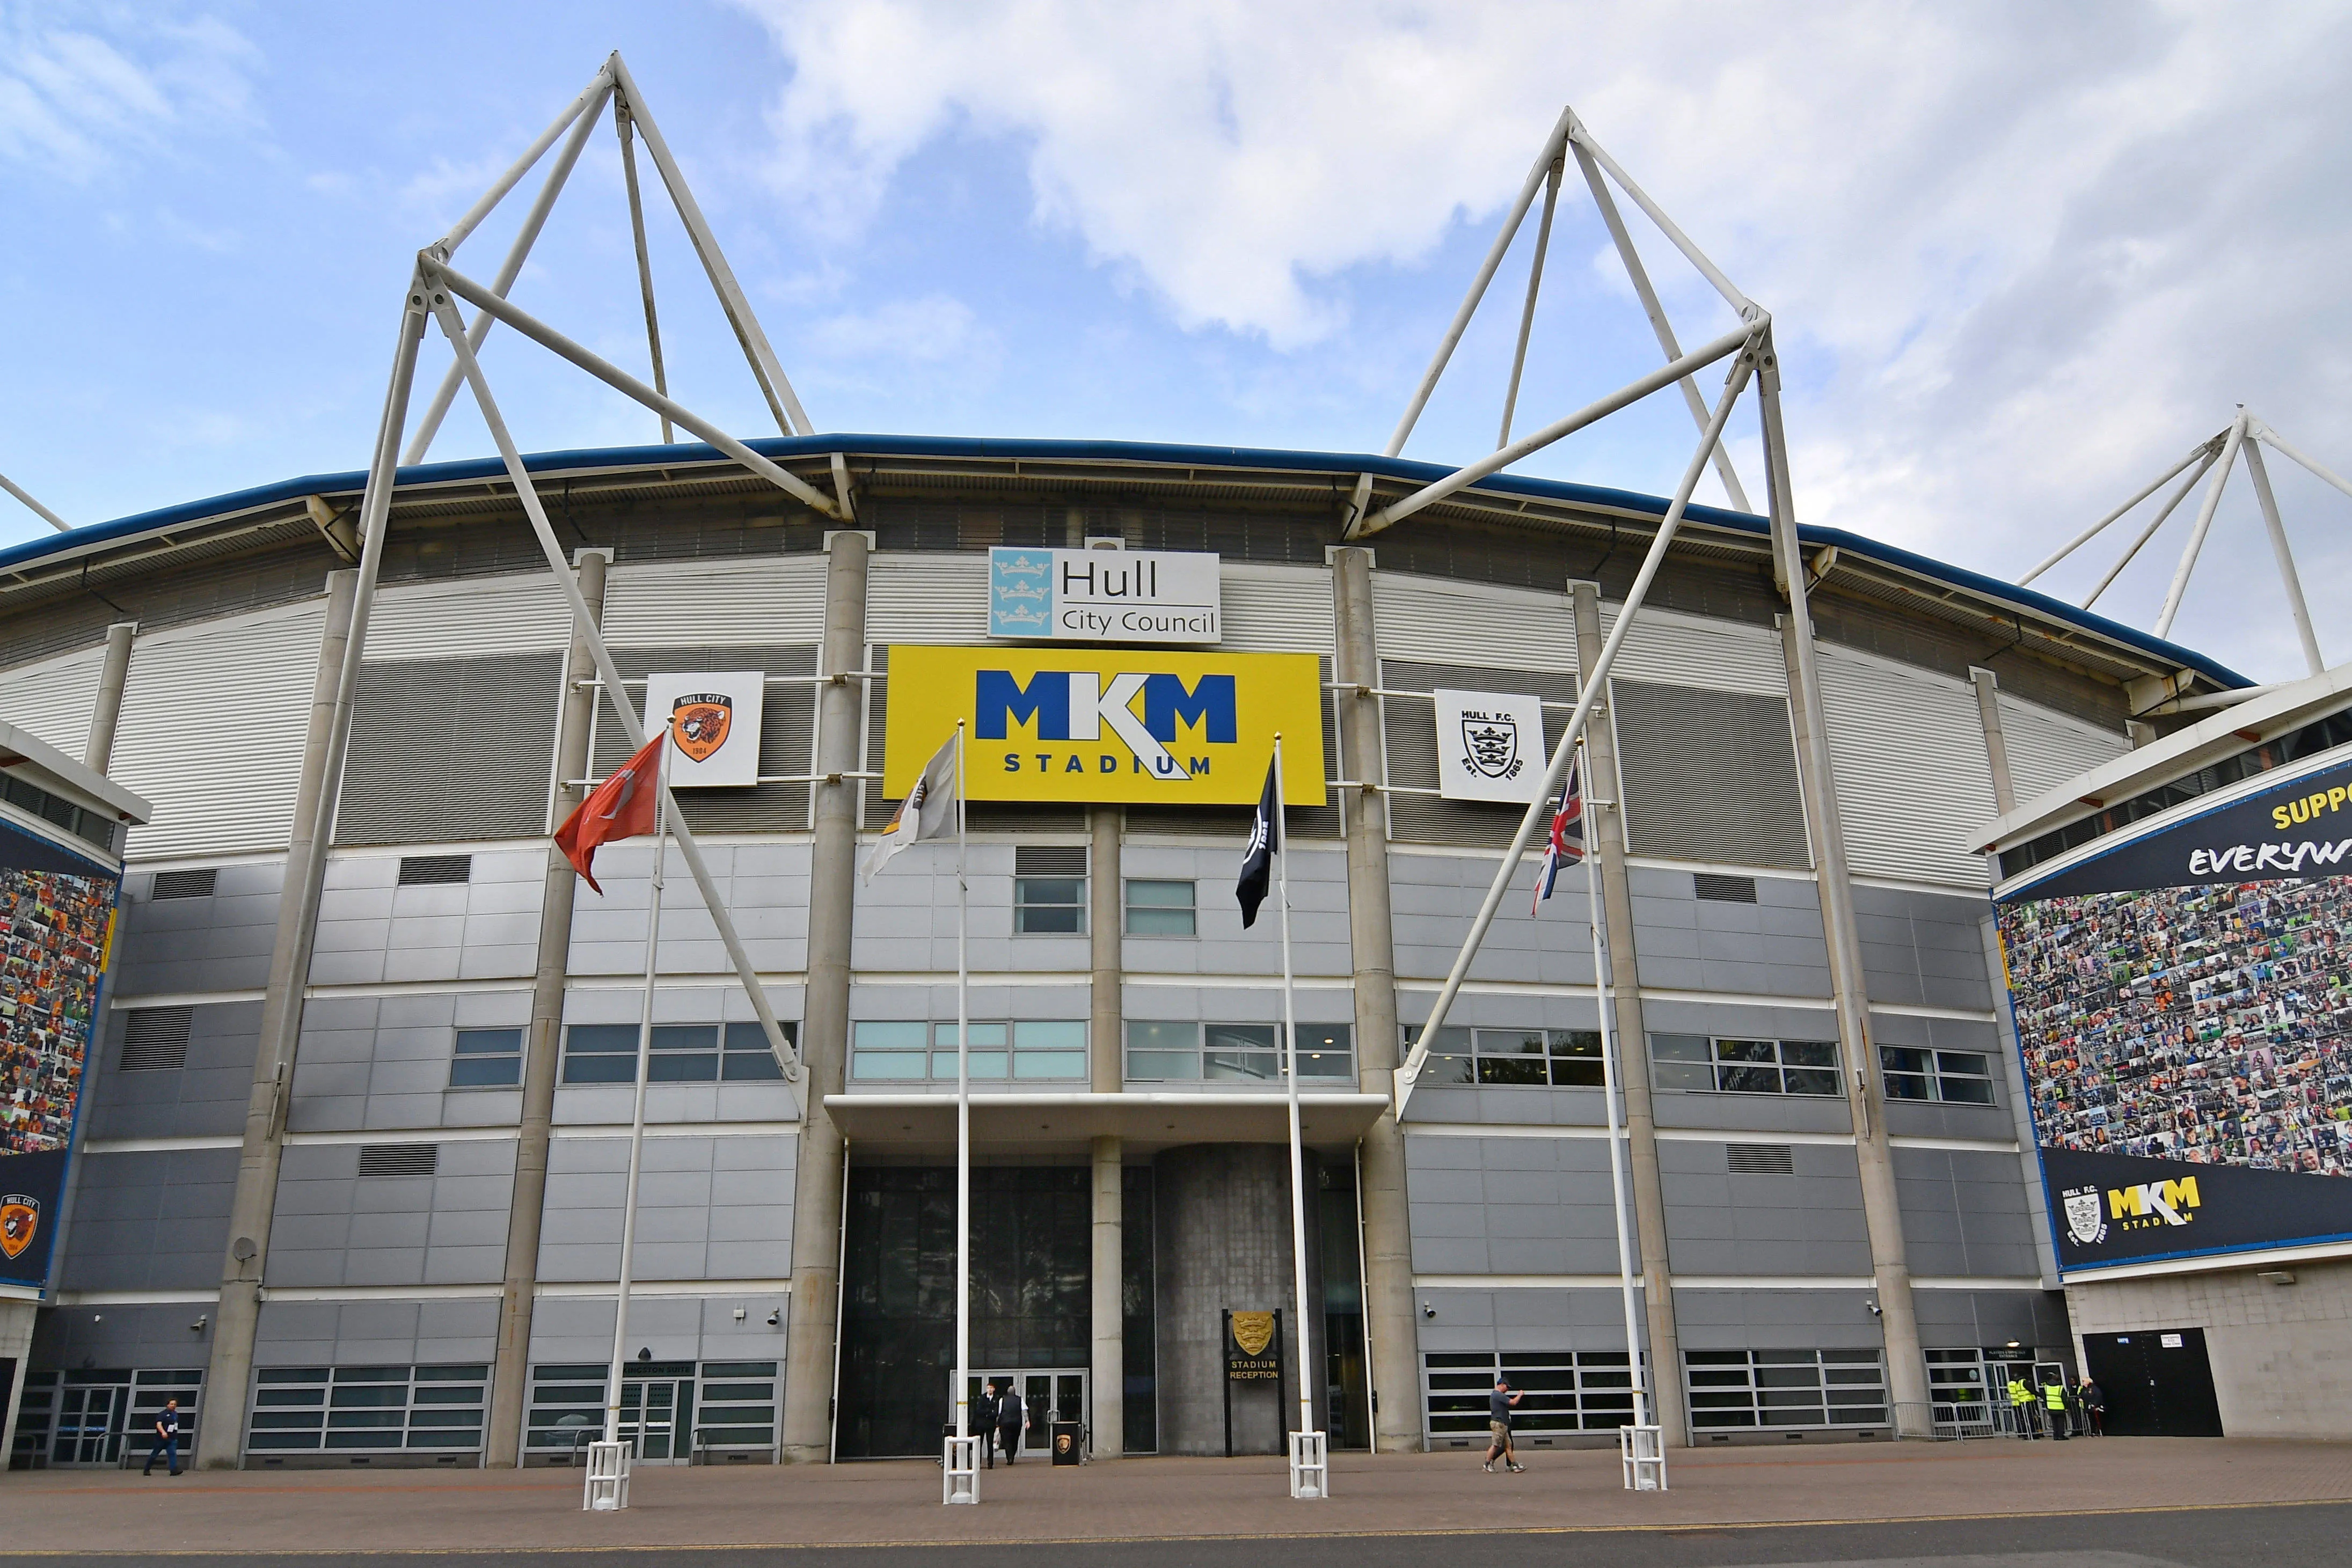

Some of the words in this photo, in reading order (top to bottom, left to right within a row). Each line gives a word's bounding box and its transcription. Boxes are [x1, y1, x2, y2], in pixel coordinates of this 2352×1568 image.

[1063, 560, 1156, 597] Hull
[1063, 610, 1112, 635] City
[1122, 612, 1215, 633] Council
[681, 695, 702, 706] HULL
[706, 694, 726, 704] CITY
[975, 670, 1238, 781] MKM
[1462, 710, 1489, 720] HULL
[1496, 713, 1515, 722] F.C.
[1004, 753, 1210, 774] STADIUM
[1506, 759, 1523, 781] 1865
[2272, 782, 2352, 829] SUPP
[2189, 838, 2352, 875] EVERYW
[23, 1198, 36, 1208] CITY
[2062, 1188, 2081, 1198] HULL
[2107, 1176, 2200, 1226] MKM
